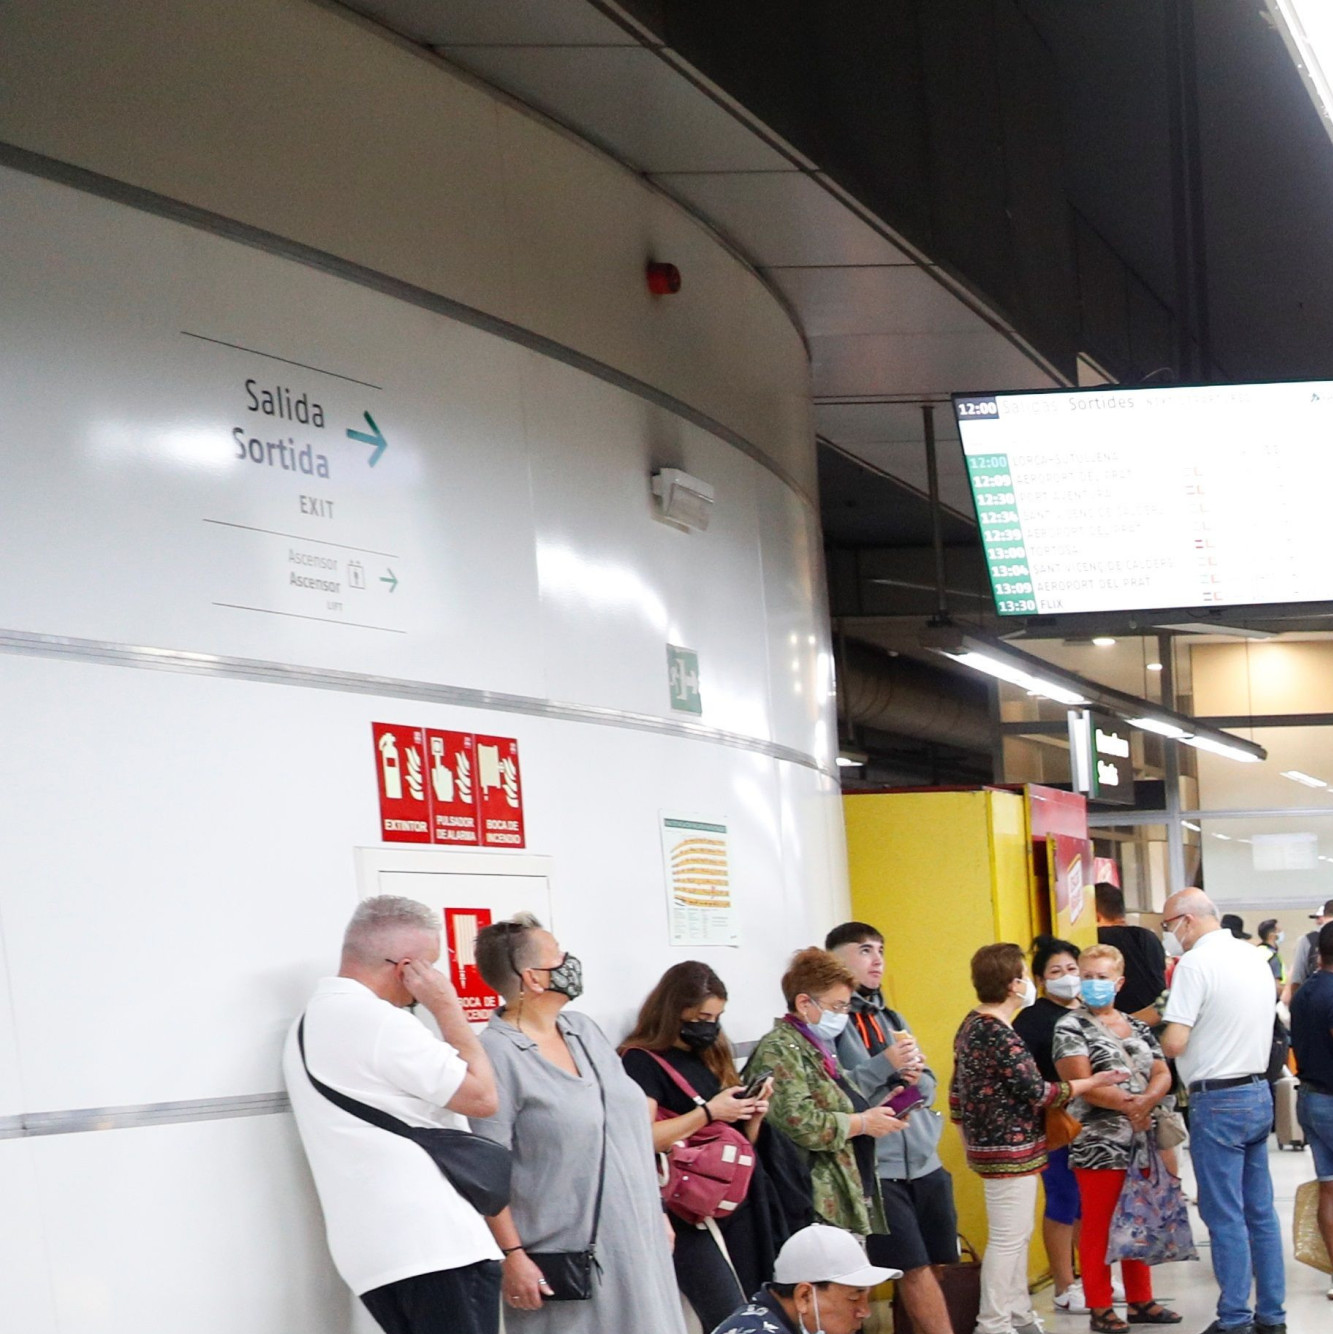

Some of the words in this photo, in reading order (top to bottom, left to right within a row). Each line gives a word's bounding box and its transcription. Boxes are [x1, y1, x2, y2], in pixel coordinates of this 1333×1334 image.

[244, 378, 325, 428] Salida
[958, 402, 997, 415] 12:00
[1068, 396, 1135, 411] Sortides
[231, 427, 330, 479] Sortida
[970, 456, 1007, 469] 12:00
[973, 474, 1012, 488] 12:09
[977, 493, 1015, 506] 12:30
[299, 495, 334, 519] EXIT
[980, 511, 1019, 524] 12:34
[984, 529, 1022, 542] 12:39
[987, 547, 1026, 560] 13:00
[288, 549, 338, 572] Ascensor
[991, 564, 1029, 577] 13:04
[289, 571, 341, 594] Ascensor
[995, 582, 1032, 595] 13:09
[1037, 579, 1094, 592] AEROPORT
[1100, 578, 1119, 589] DEL
[1123, 576, 1151, 588] PRAT
[998, 600, 1036, 612] 13:30
[1040, 599, 1064, 610] FLIX
[385, 819, 428, 832] EXTINTOR
[435, 815, 476, 828] PULSADOR
[486, 819, 506, 831] BOCA
[507, 820, 519, 832] DE
[435, 828, 448, 840] DE
[449, 829, 477, 841] ALARMA
[486, 832, 521, 845] INCENDIO
[484, 996, 497, 1007] DE
